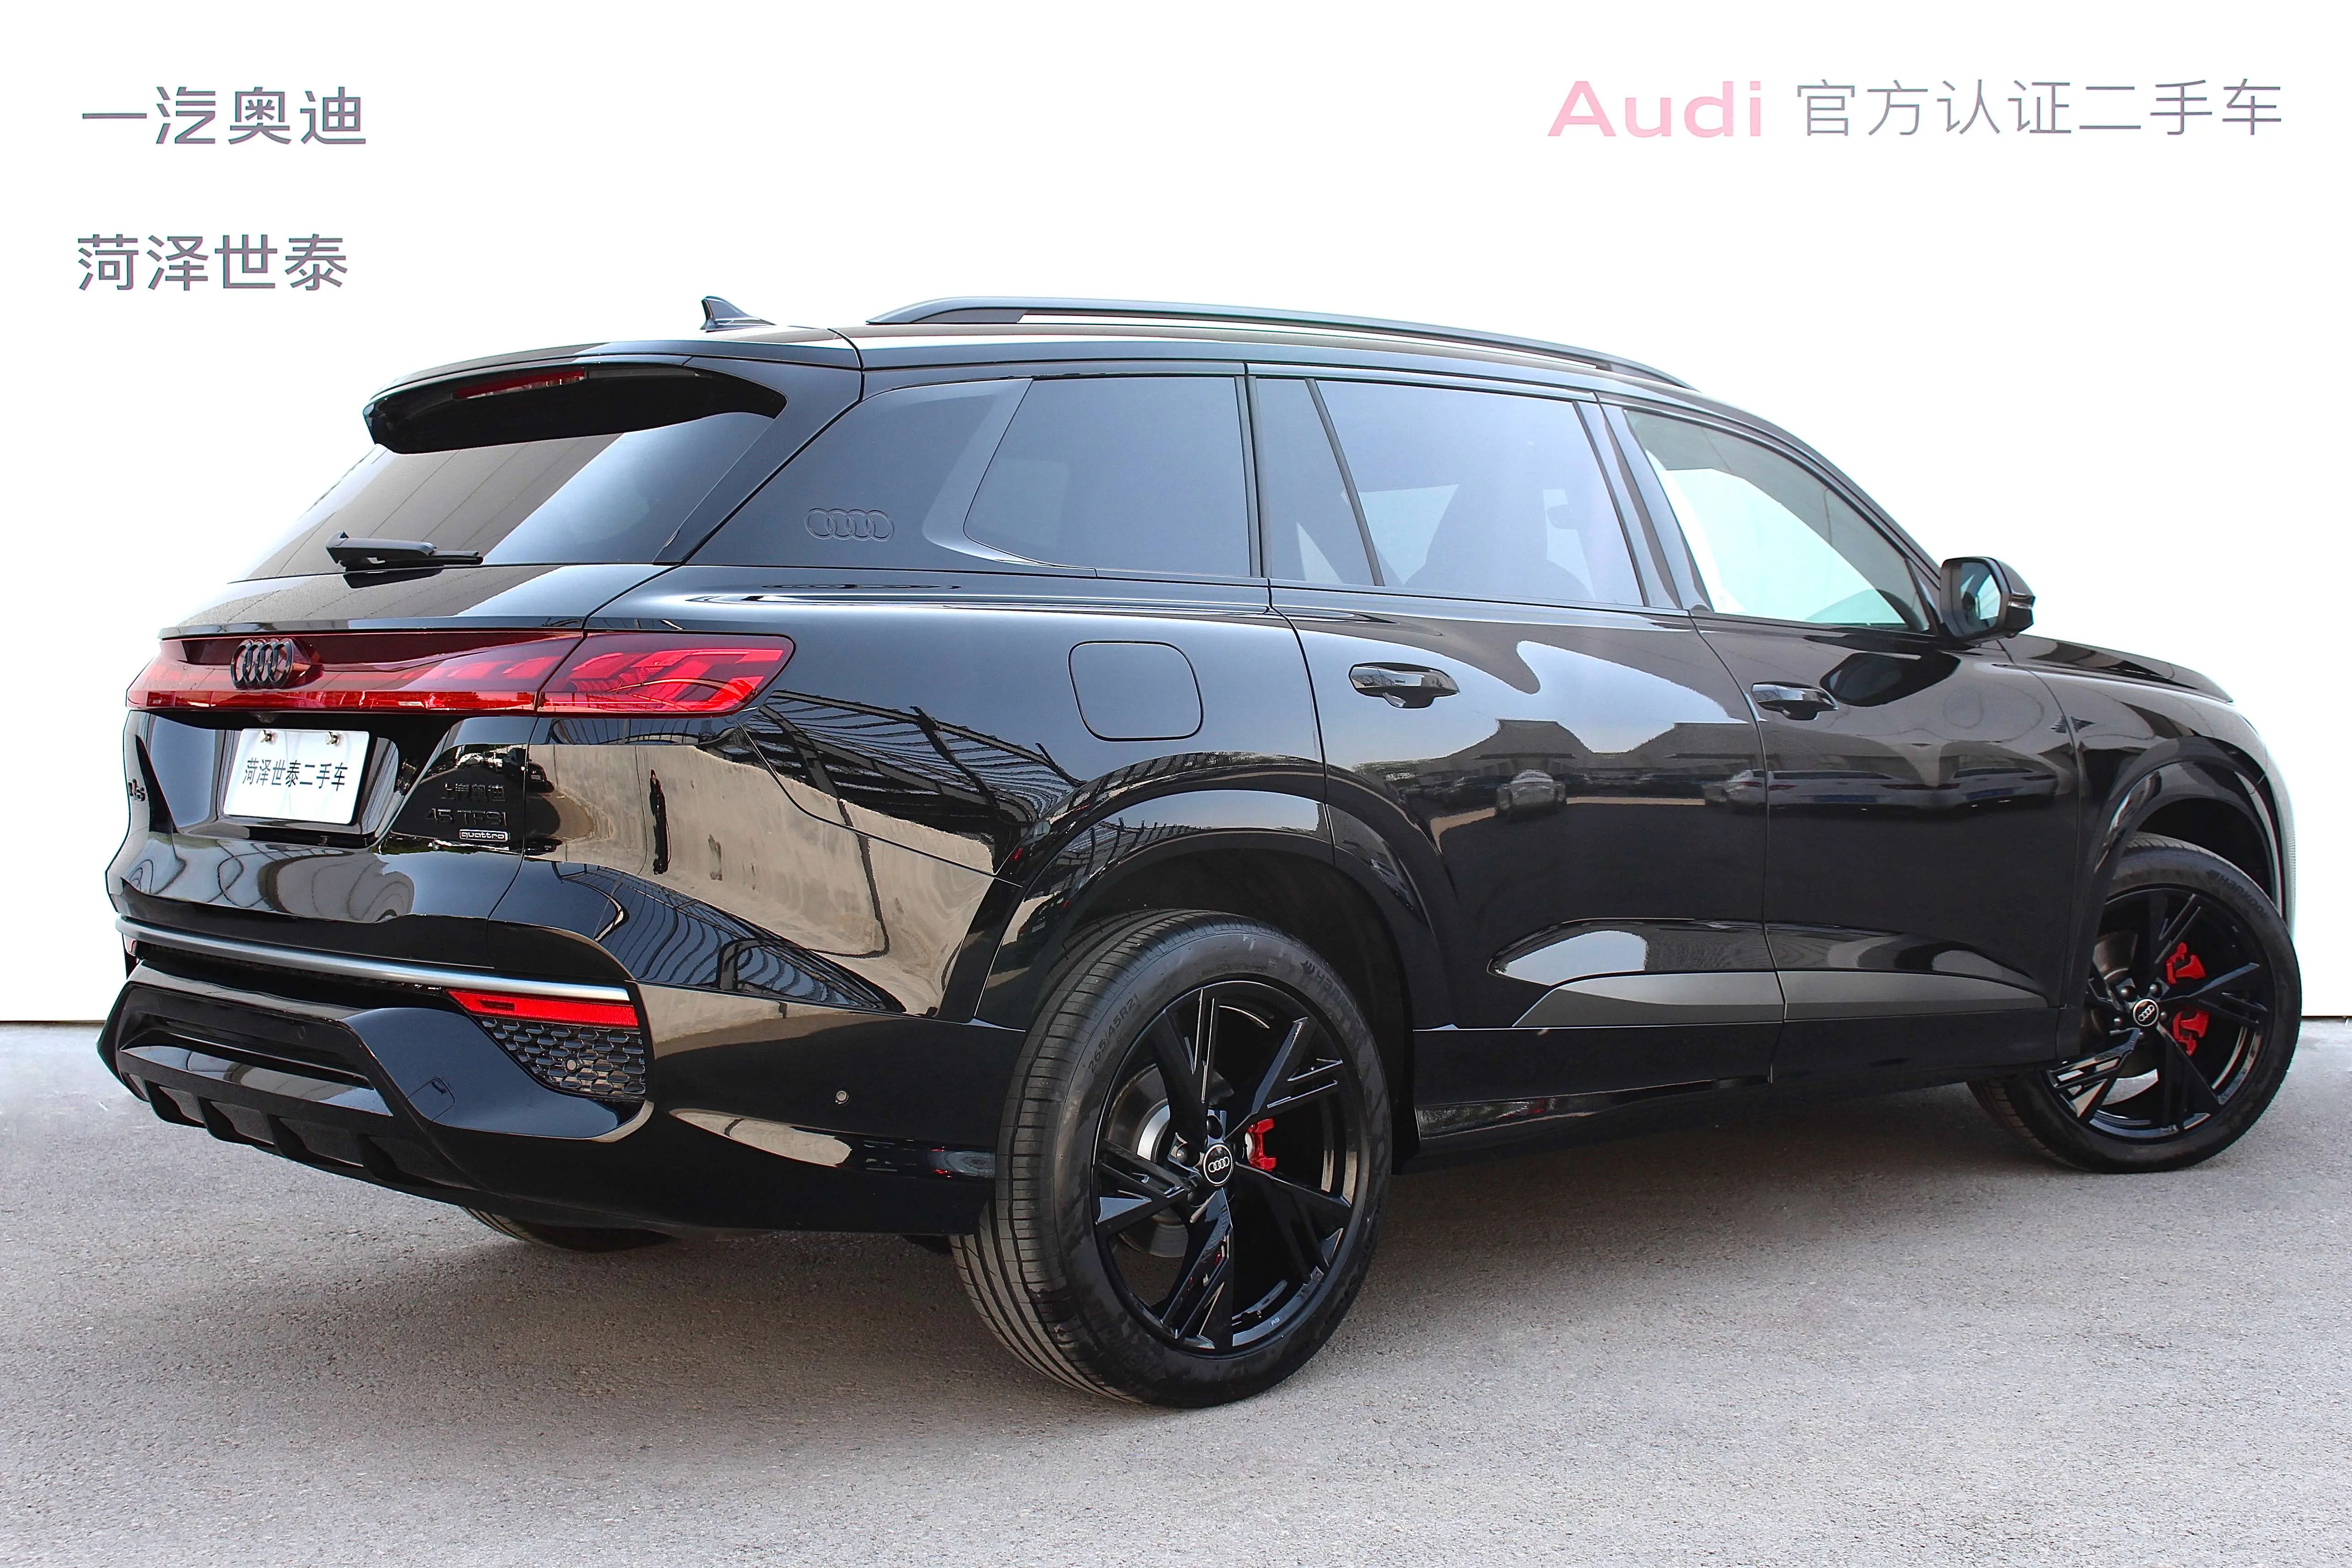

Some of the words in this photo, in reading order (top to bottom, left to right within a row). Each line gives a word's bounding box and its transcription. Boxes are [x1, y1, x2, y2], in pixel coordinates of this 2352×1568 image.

[82, 86, 366, 144] 一汽奥迪
[1548, 81, 1761, 138] Audi
[1798, 79, 2282, 136] 官方认证二手车
[77, 234, 348, 291] 菏泽世泰
[243, 757, 348, 791] 菏泽世泰二手车
[423, 808, 455, 823] 45
[457, 810, 507, 827] TFSI
[461, 831, 505, 840] quattro
[1088, 994, 1139, 1074] 265/45R21
